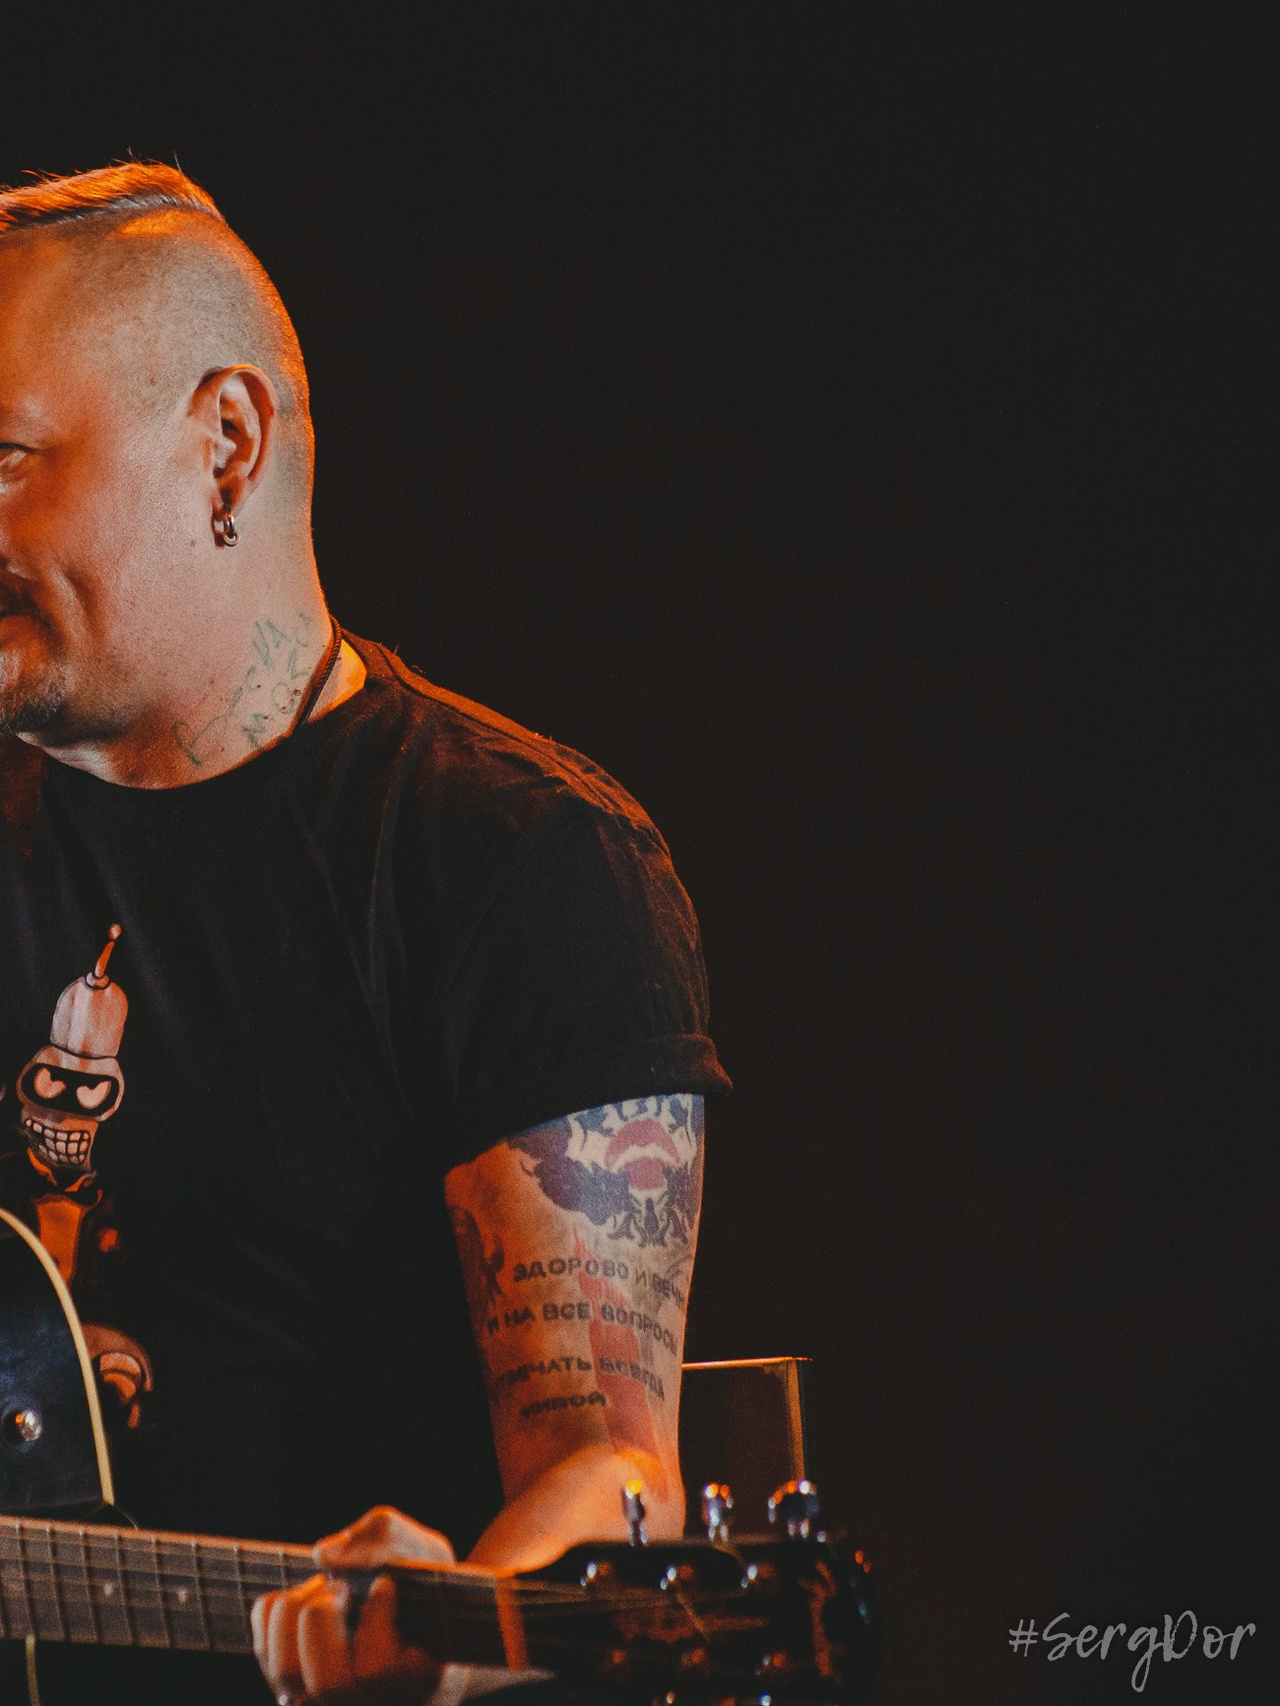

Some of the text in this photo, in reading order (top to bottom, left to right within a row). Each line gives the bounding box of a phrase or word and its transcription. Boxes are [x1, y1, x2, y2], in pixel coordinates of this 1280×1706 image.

[513, 1257, 629, 1283] ЗДОРОВО
[503, 1306, 537, 1328] НА
[542, 1301, 591, 1322] ВСЕ
